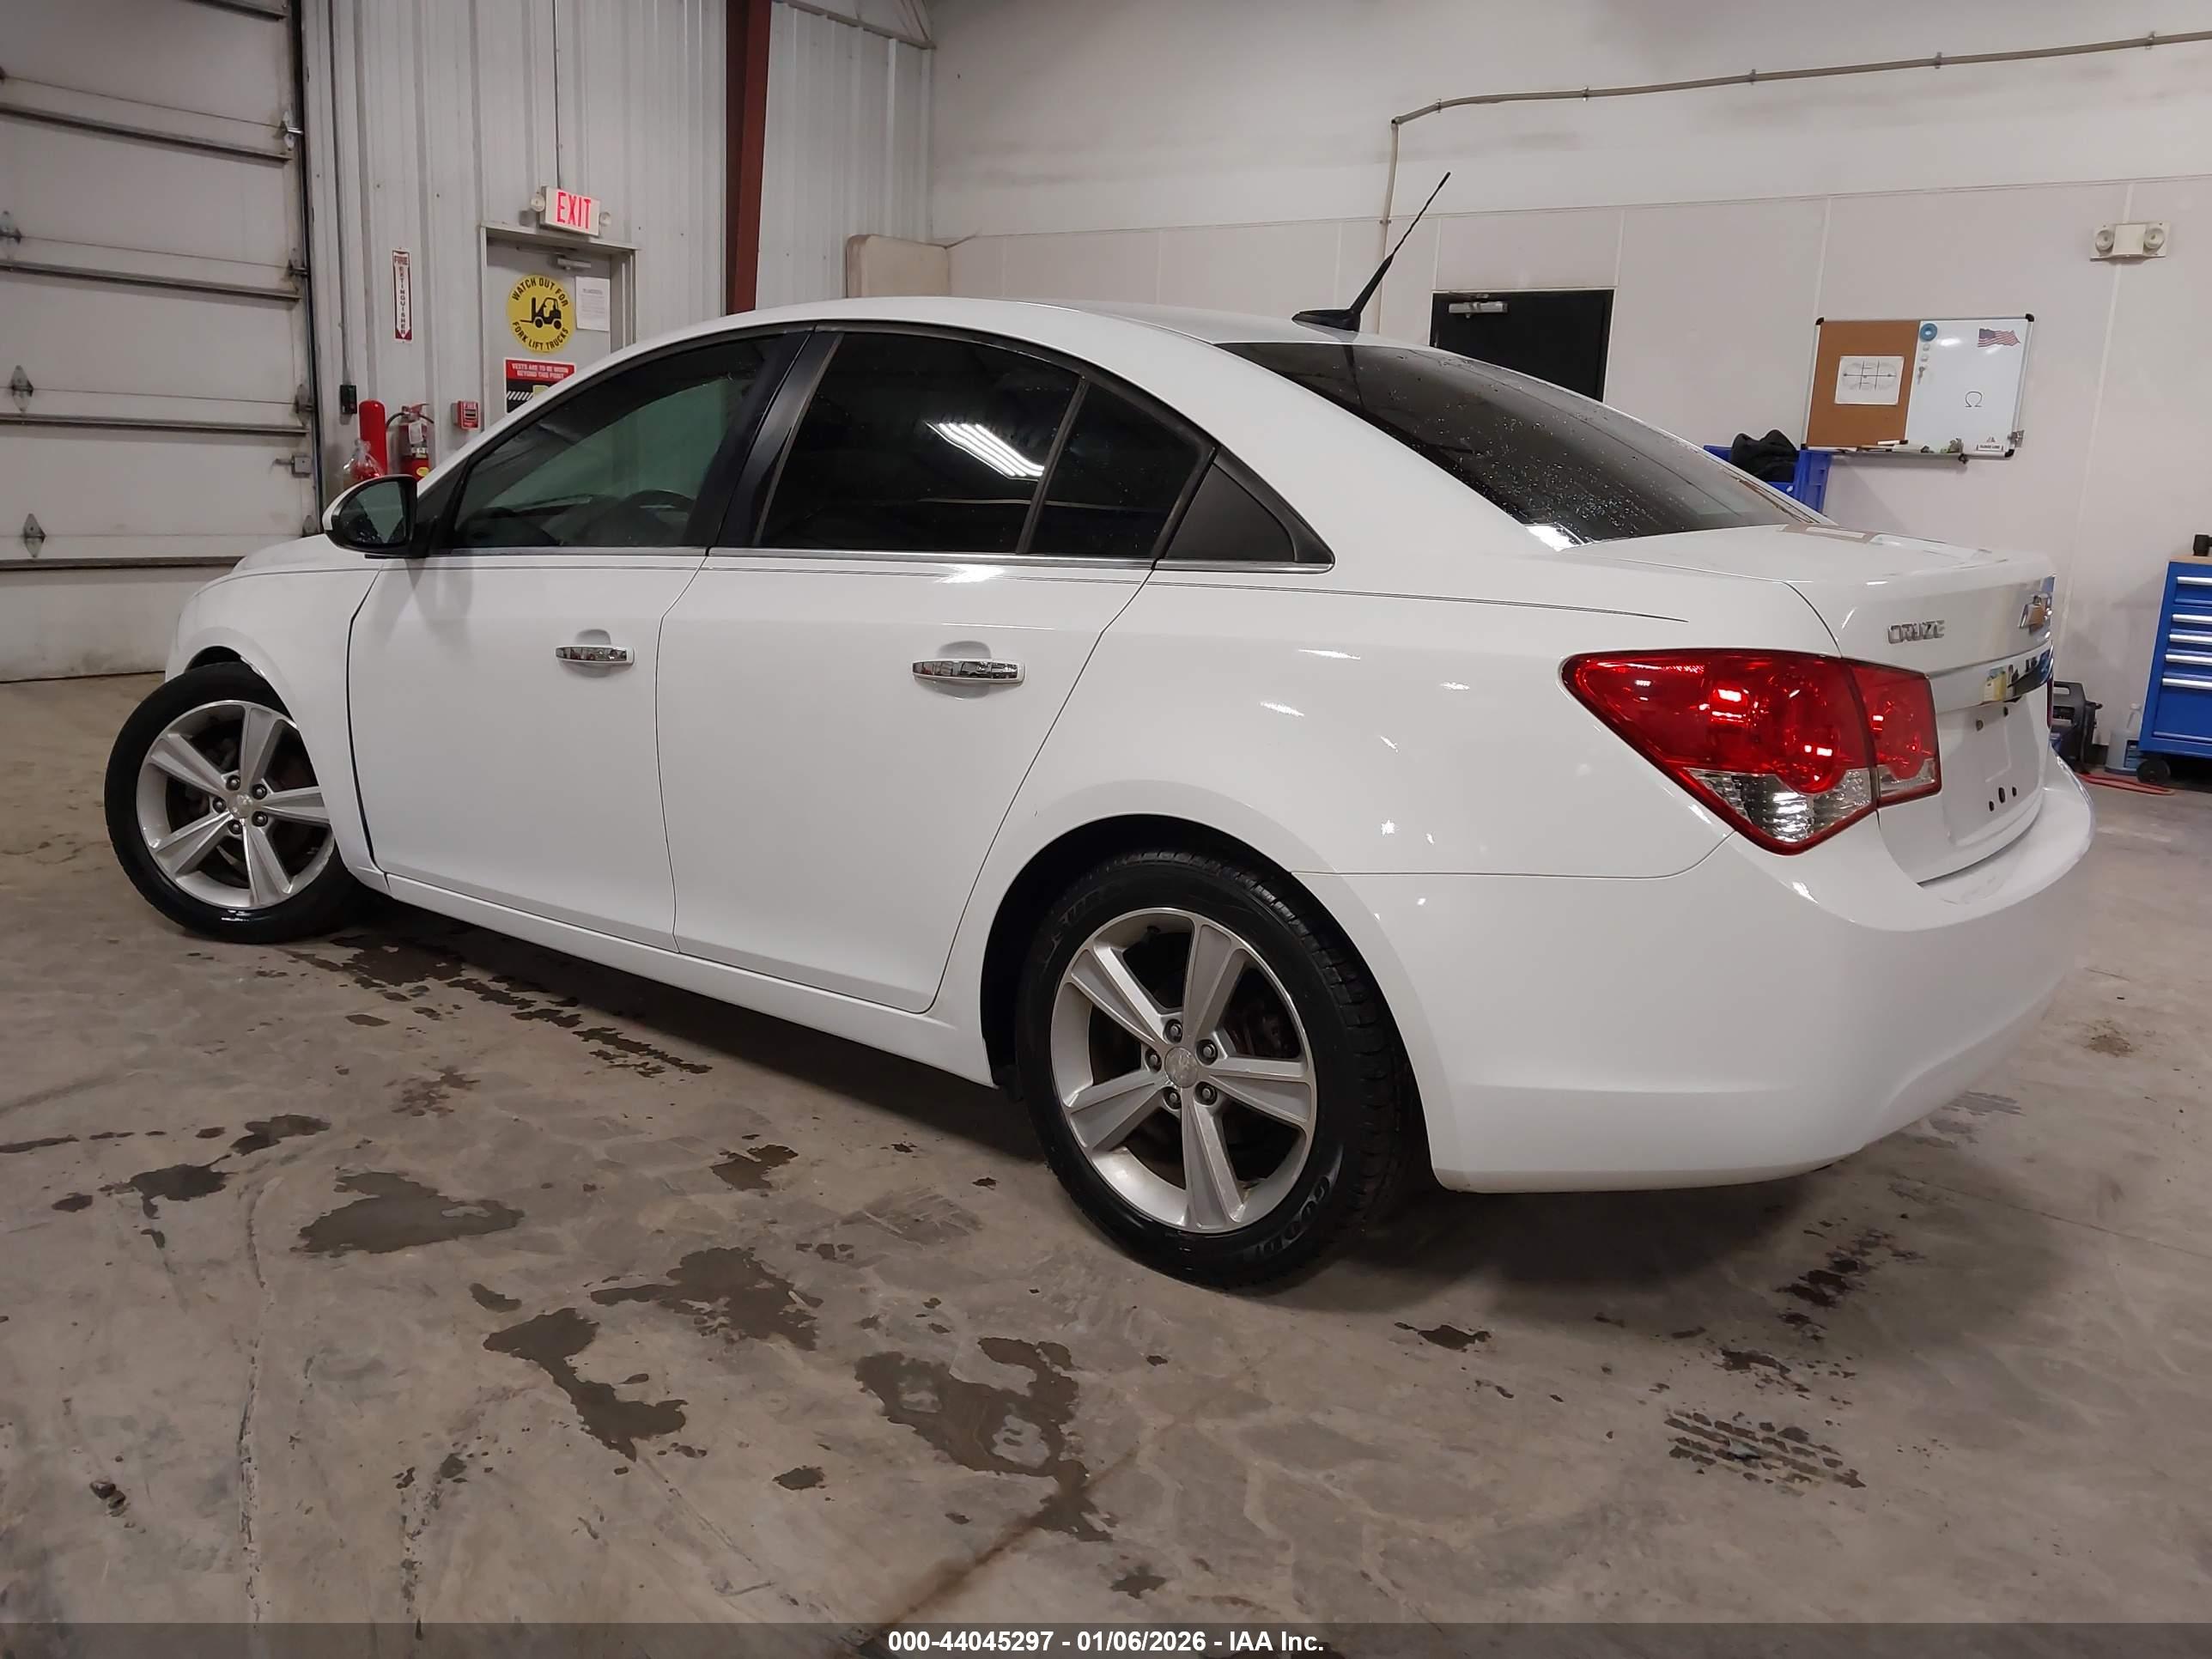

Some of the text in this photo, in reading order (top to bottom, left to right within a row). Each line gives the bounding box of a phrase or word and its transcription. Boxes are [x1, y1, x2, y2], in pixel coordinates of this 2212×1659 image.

[556, 191, 592, 229] EXIT
[512, 277, 568, 307] WATCH OUT FOR
[513, 321, 568, 351] FORK LIFT TRUCKS
